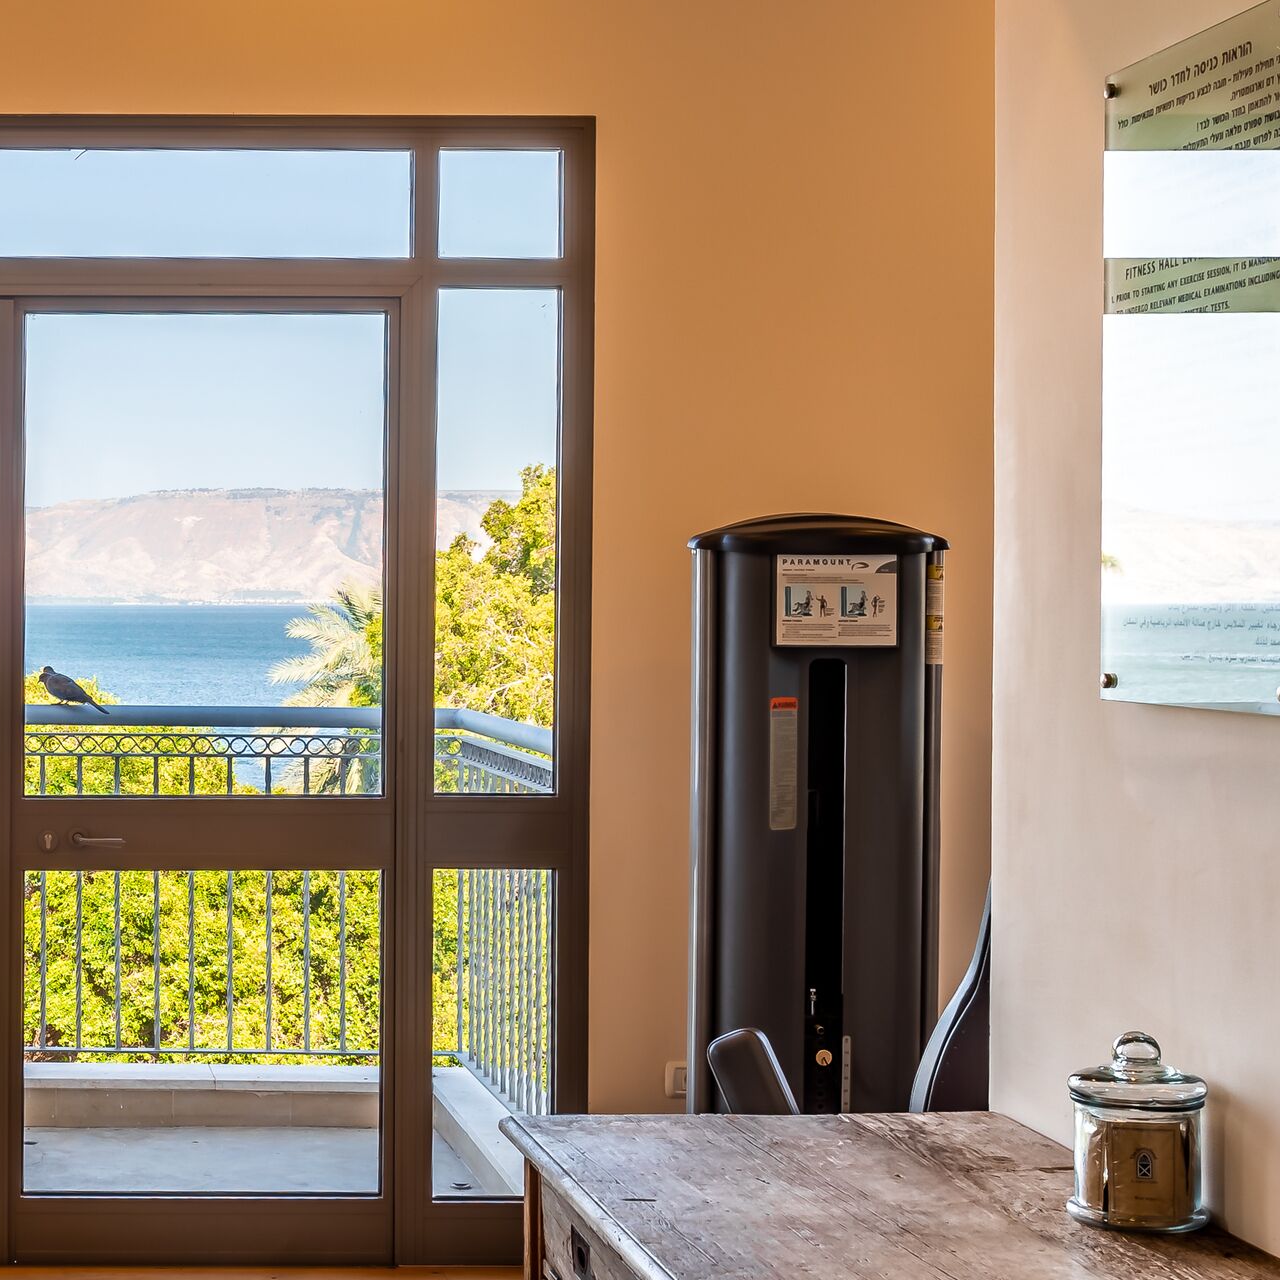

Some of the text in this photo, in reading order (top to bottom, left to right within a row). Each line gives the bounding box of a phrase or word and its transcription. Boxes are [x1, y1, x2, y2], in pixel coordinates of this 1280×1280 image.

[1148, 41, 1252, 97] הוראות כניסה לחדר כושר
[1115, 291, 1131, 303] PRIOR
[1132, 289, 1140, 298] TO
[1141, 283, 1166, 297] STARTING
[1167, 278, 1179, 289] ANY
[1180, 271, 1205, 286] EXERCISE
[1206, 265, 1232, 280] SESSION,
[1232, 262, 1239, 273] IT
[1240, 260, 1247, 270] IS
[1125, 260, 1156, 281] FITNESS
[1158, 258, 1179, 271] HALL
[1149, 296, 1177, 310] RELEVANT
[1177, 291, 1202, 303] MEDICAL
[1203, 278, 1247, 297] EXAMINATIONS
[1247, 270, 1280, 286] INCLUDING
[1210, 300, 1231, 312] TESTS.
[782, 558, 851, 566] PARAMOUNT
